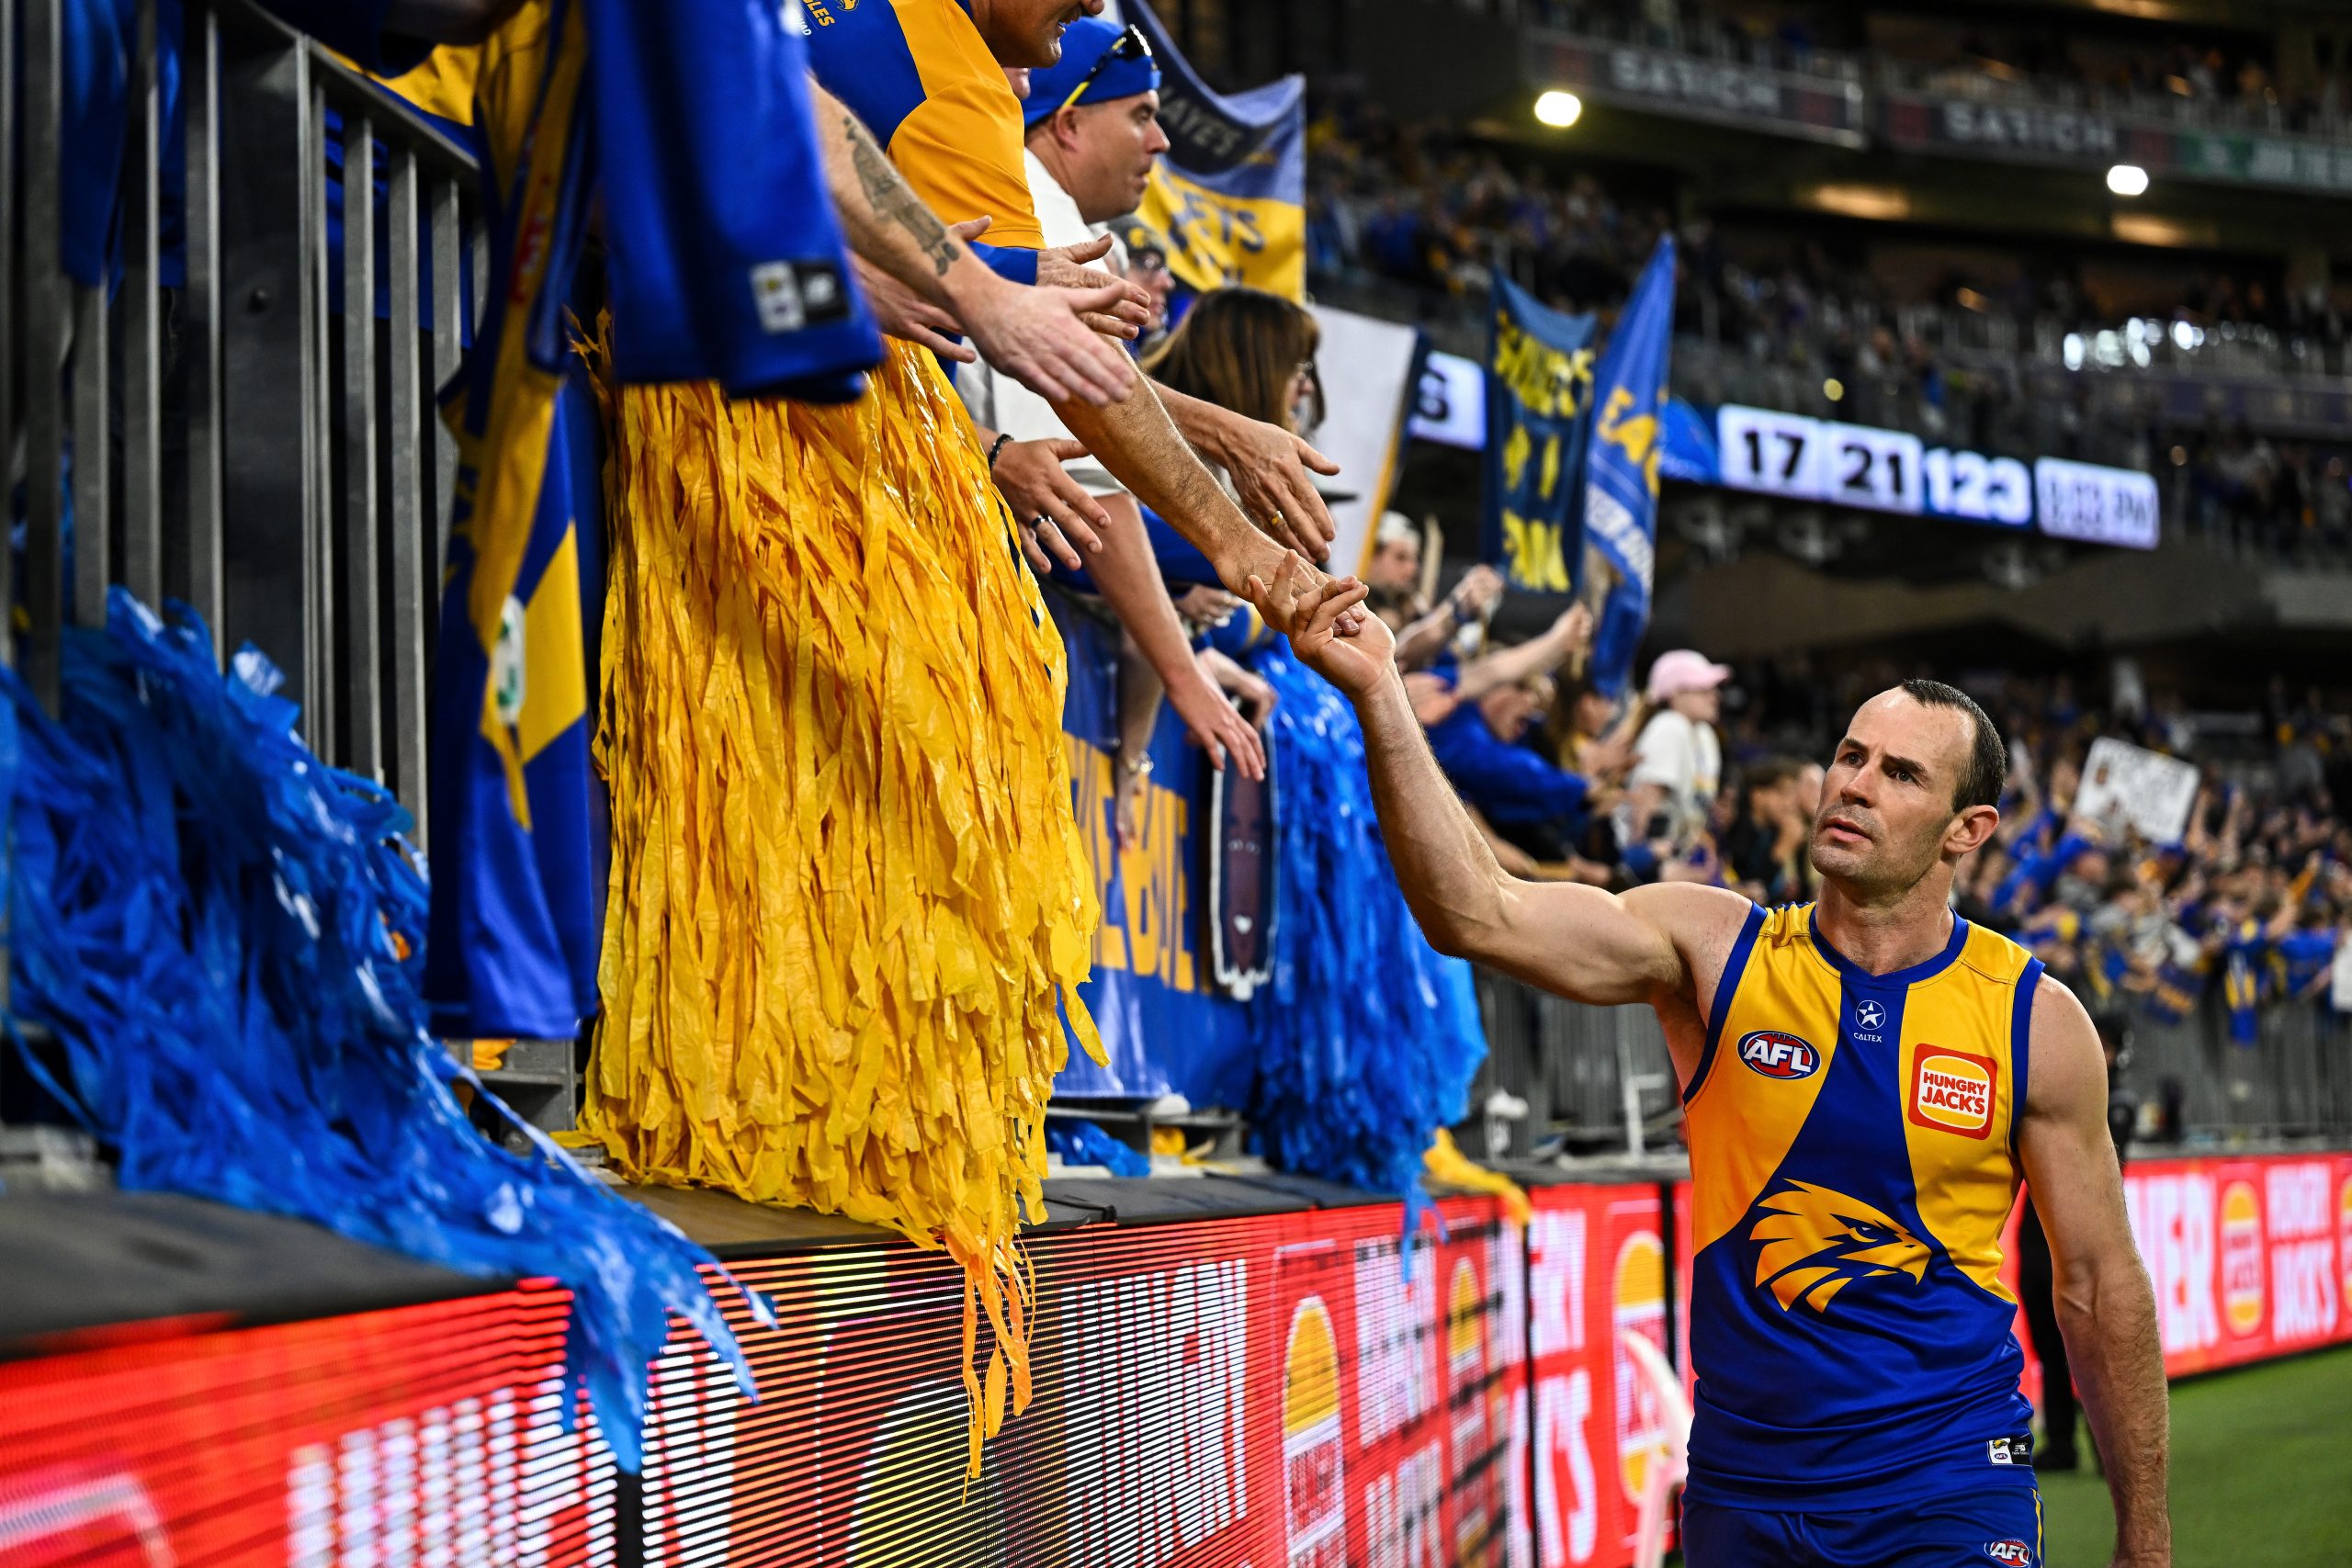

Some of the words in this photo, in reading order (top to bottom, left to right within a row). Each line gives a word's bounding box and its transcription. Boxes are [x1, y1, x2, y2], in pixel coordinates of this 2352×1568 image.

[1743, 430, 1805, 479] 17
[1843, 444, 1903, 496] 21
[1926, 446, 2032, 525] 123
[1853, 1032, 1883, 1043] CALTEX
[1743, 1038, 1812, 1073] AFL
[1923, 1071, 1986, 1096] HUNGRY
[1921, 1086, 1985, 1115] JACK'S
[1990, 1543, 2030, 1564] AFL
